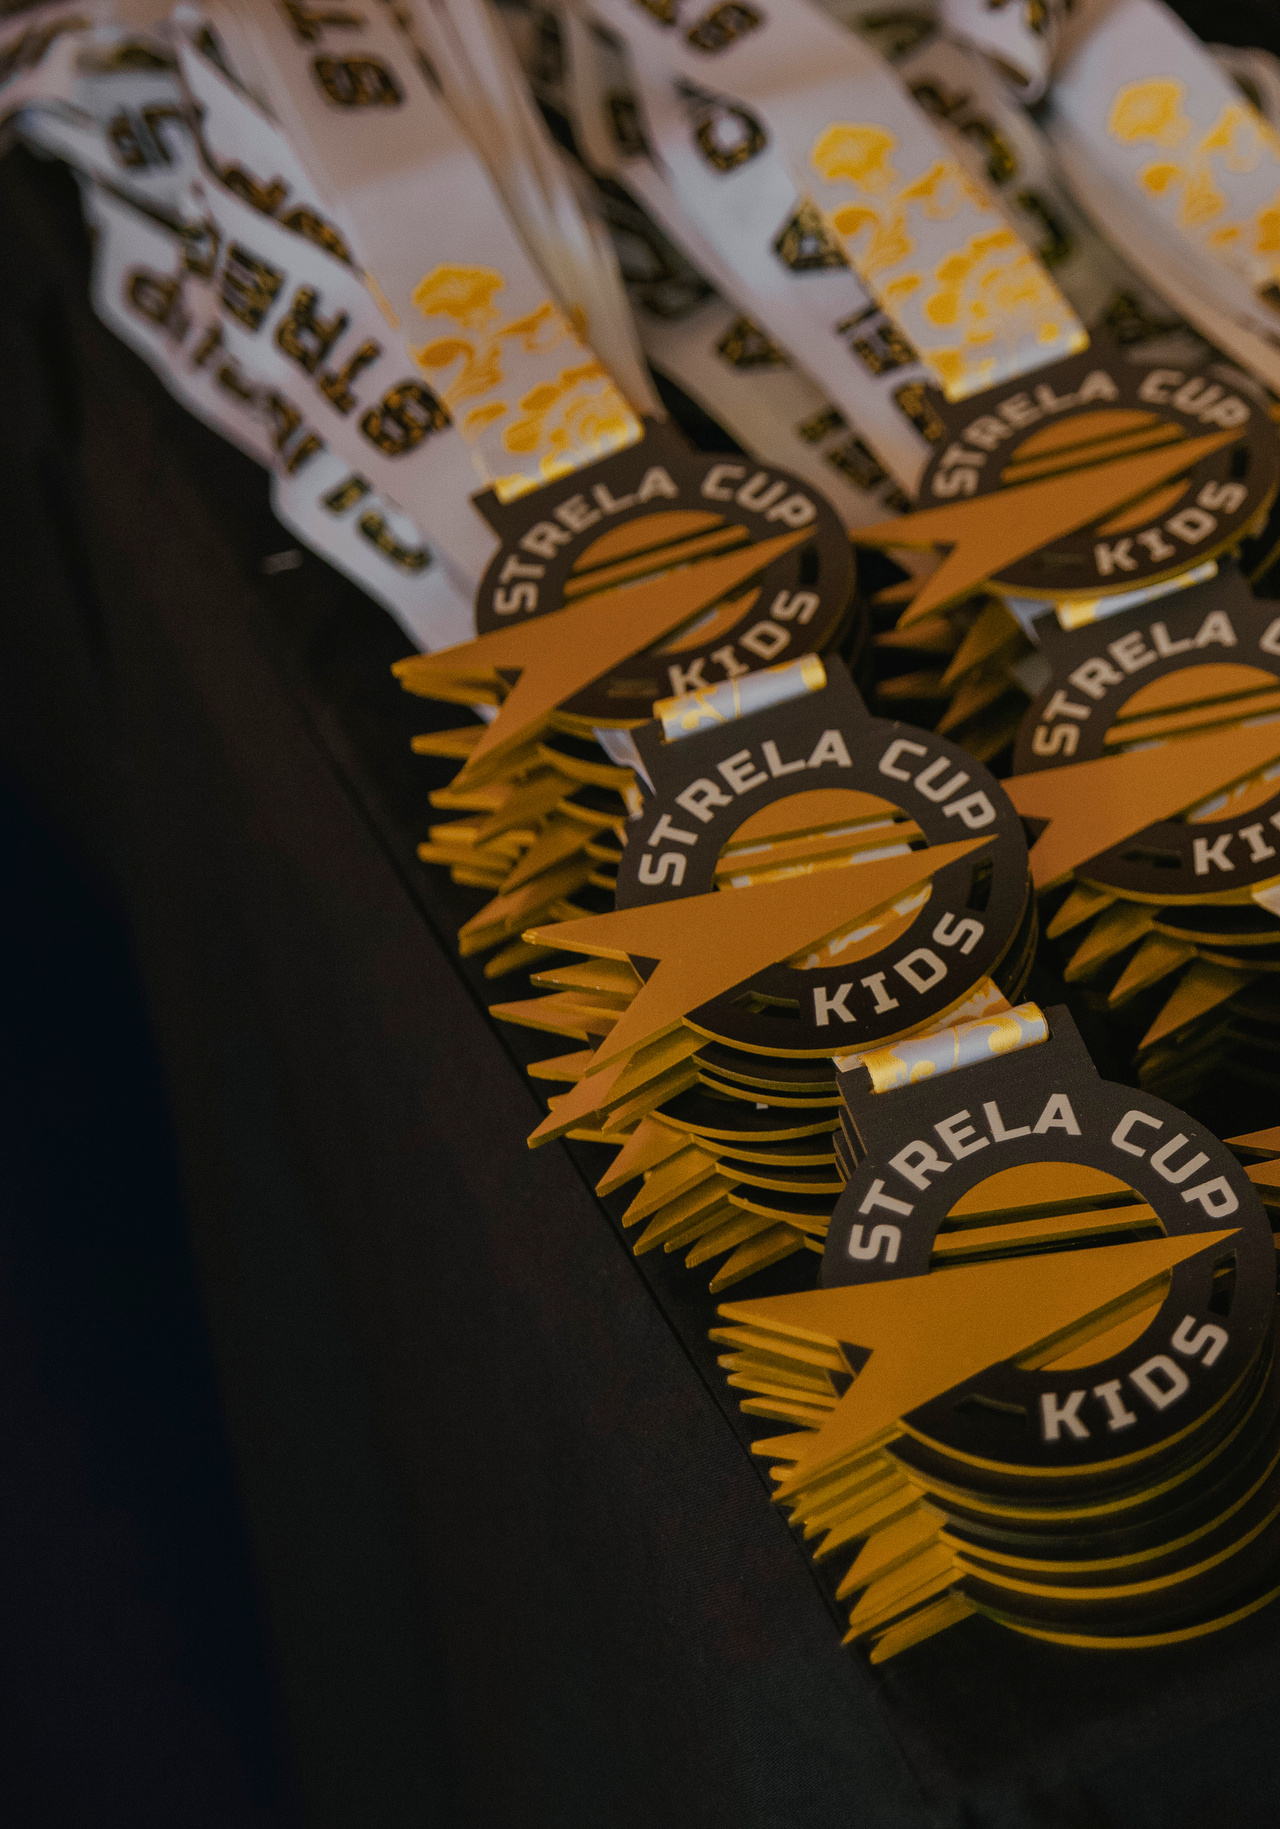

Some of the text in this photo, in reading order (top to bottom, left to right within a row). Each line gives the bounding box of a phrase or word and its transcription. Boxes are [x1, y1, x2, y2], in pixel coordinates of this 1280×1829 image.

[931, 368, 1119, 499] STRELA
[1138, 368, 1251, 429] CUP
[493, 466, 680, 616] STRELA
[701, 464, 818, 528] CUP
[1094, 479, 1249, 576] KIDS
[668, 589, 820, 700] KIDS
[1032, 610, 1238, 757] STRELA
[638, 729, 997, 887] STRELA CUP
[812, 911, 985, 1026] KIDS
[848, 1093, 1240, 1264] STRELA CUP
[1039, 1315, 1230, 1441] KIDS
